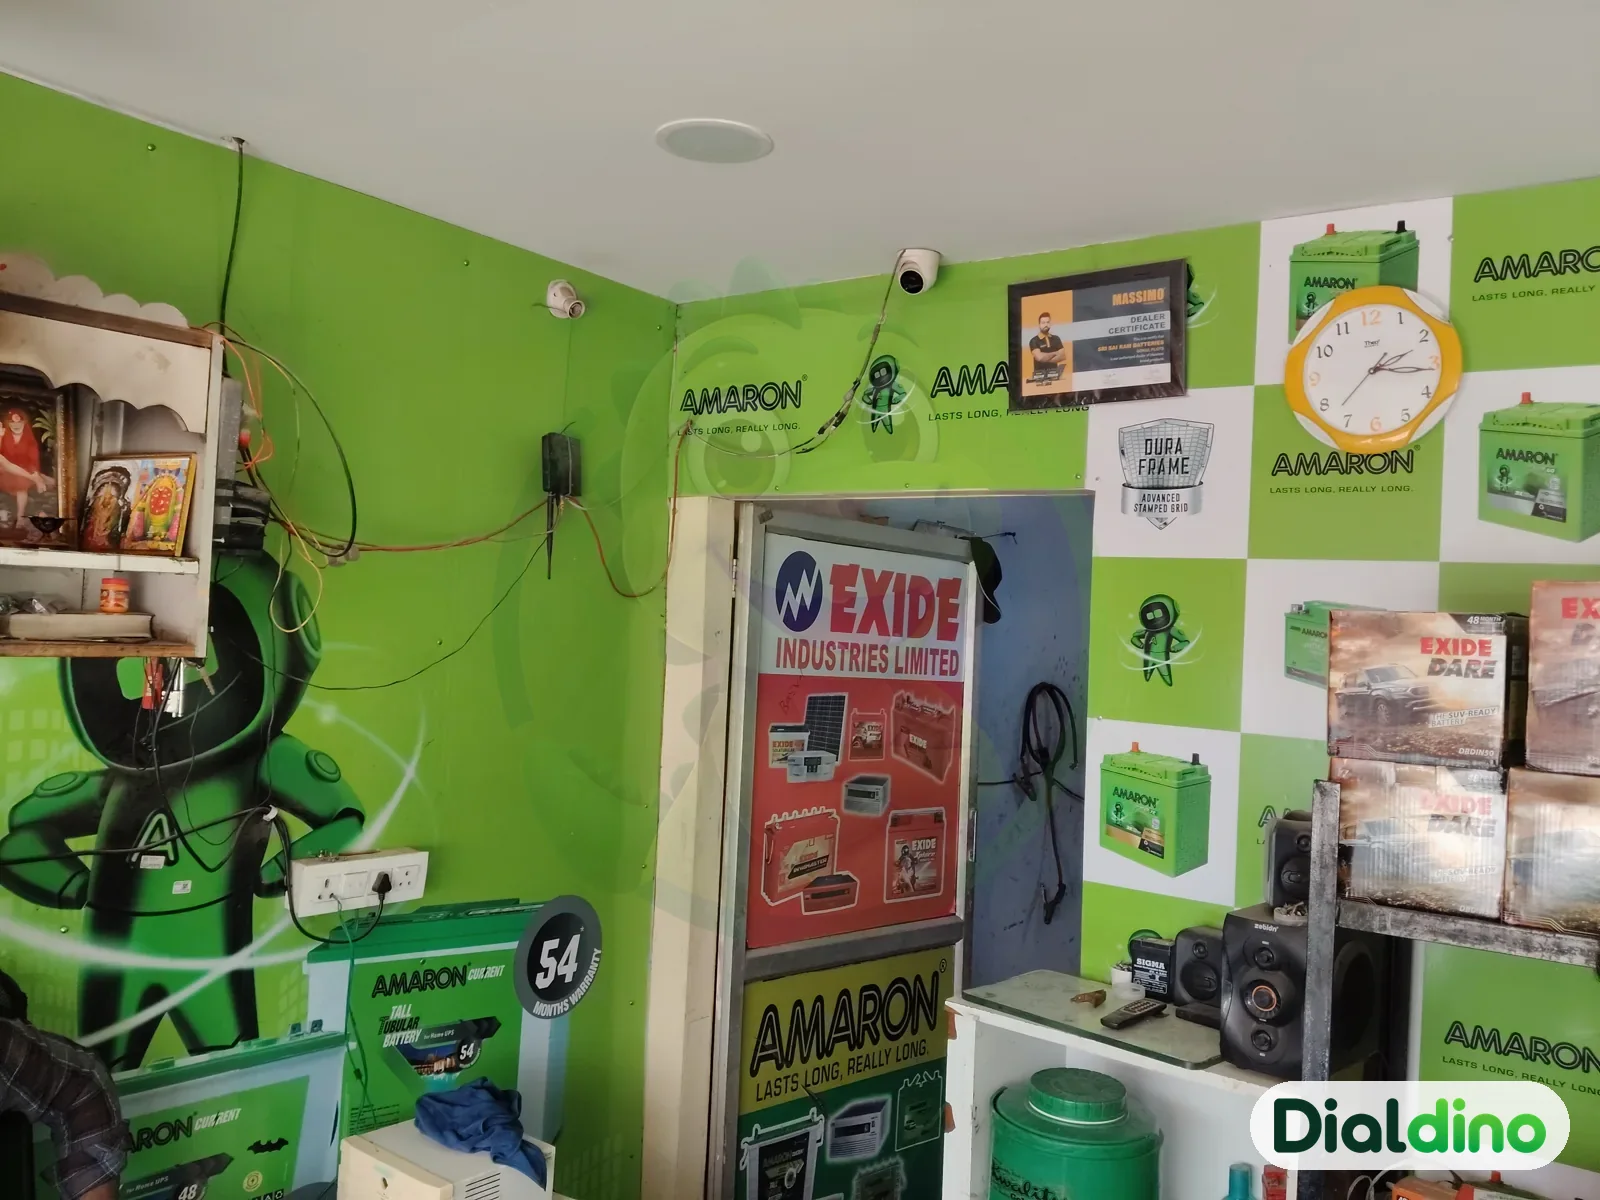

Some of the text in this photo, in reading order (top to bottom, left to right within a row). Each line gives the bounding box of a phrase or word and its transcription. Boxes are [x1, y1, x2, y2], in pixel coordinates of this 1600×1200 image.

[1304, 276, 1355, 290] AMARON
[1112, 288, 1165, 306] MASSIMO
[1472, 292, 1507, 302] LASTS
[1552, 285, 1596, 295] REALLY
[1131, 313, 1165, 324] DEALER
[1361, 310, 1382, 326] 12
[1397, 311, 1404, 325] 1
[1108, 322, 1166, 335] CERTIFICATE
[1336, 321, 1350, 336] 11
[1419, 328, 1429, 343] 2
[1316, 344, 1333, 358] 10
[1428, 355, 1440, 369] 3
[931, 361, 1009, 398] AMA
[1309, 371, 1320, 386] 9
[680, 380, 802, 415] AMARON
[1421, 385, 1431, 398] 4
[1319, 398, 1329, 411] 8
[928, 412, 962, 421] LASTS
[1344, 414, 1352, 428] 7
[1401, 408, 1411, 422] 5
[736, 425, 768, 433] REALLY
[1370, 416, 1382, 432] 6
[1145, 437, 1183, 455] DURA
[1271, 449, 1414, 476] AMARON
[1496, 448, 1555, 465] AMARON
[1138, 457, 1190, 475] FRAME
[1141, 493, 1181, 503] ADVANCED
[1134, 502, 1188, 513] STAMPED GRID
[829, 563, 962, 641] EXIDE
[1467, 616, 1480, 625] 48
[1420, 637, 1492, 657] EXIDE
[776, 637, 960, 677] INDUSTRIES LIMITED
[1427, 658, 1497, 679] DARE
[1431, 719, 1464, 727] BATTERY
[1112, 786, 1157, 808] AMARON
[911, 838, 937, 850] EXIDE
[535, 934, 580, 989] 54
[1136, 957, 1165, 969] SIGMA
[372, 965, 505, 998] AMARON CURRENT
[533, 948, 602, 1017] MONTHS WARRANTY
[390, 1004, 412, 1019] TALL
[750, 971, 939, 1077] AMARON
[383, 1029, 422, 1048] BATTERY
[430, 1031, 443, 1039] Home
[444, 1029, 454, 1037] UPS
[460, 1043, 475, 1060] 54
[756, 1039, 929, 1102] LASTS LONG, REALLY LONG.
[1442, 1055, 1478, 1069] LASTS
[1521, 1072, 1566, 1088] REALLY
[1572, 1083, 1600, 1096] LON
[194, 1108, 242, 1131] CURRENT
[135, 1182, 154, 1192] Home
[155, 1176, 169, 1185] UPS
[178, 1184, 198, 1200] 48
